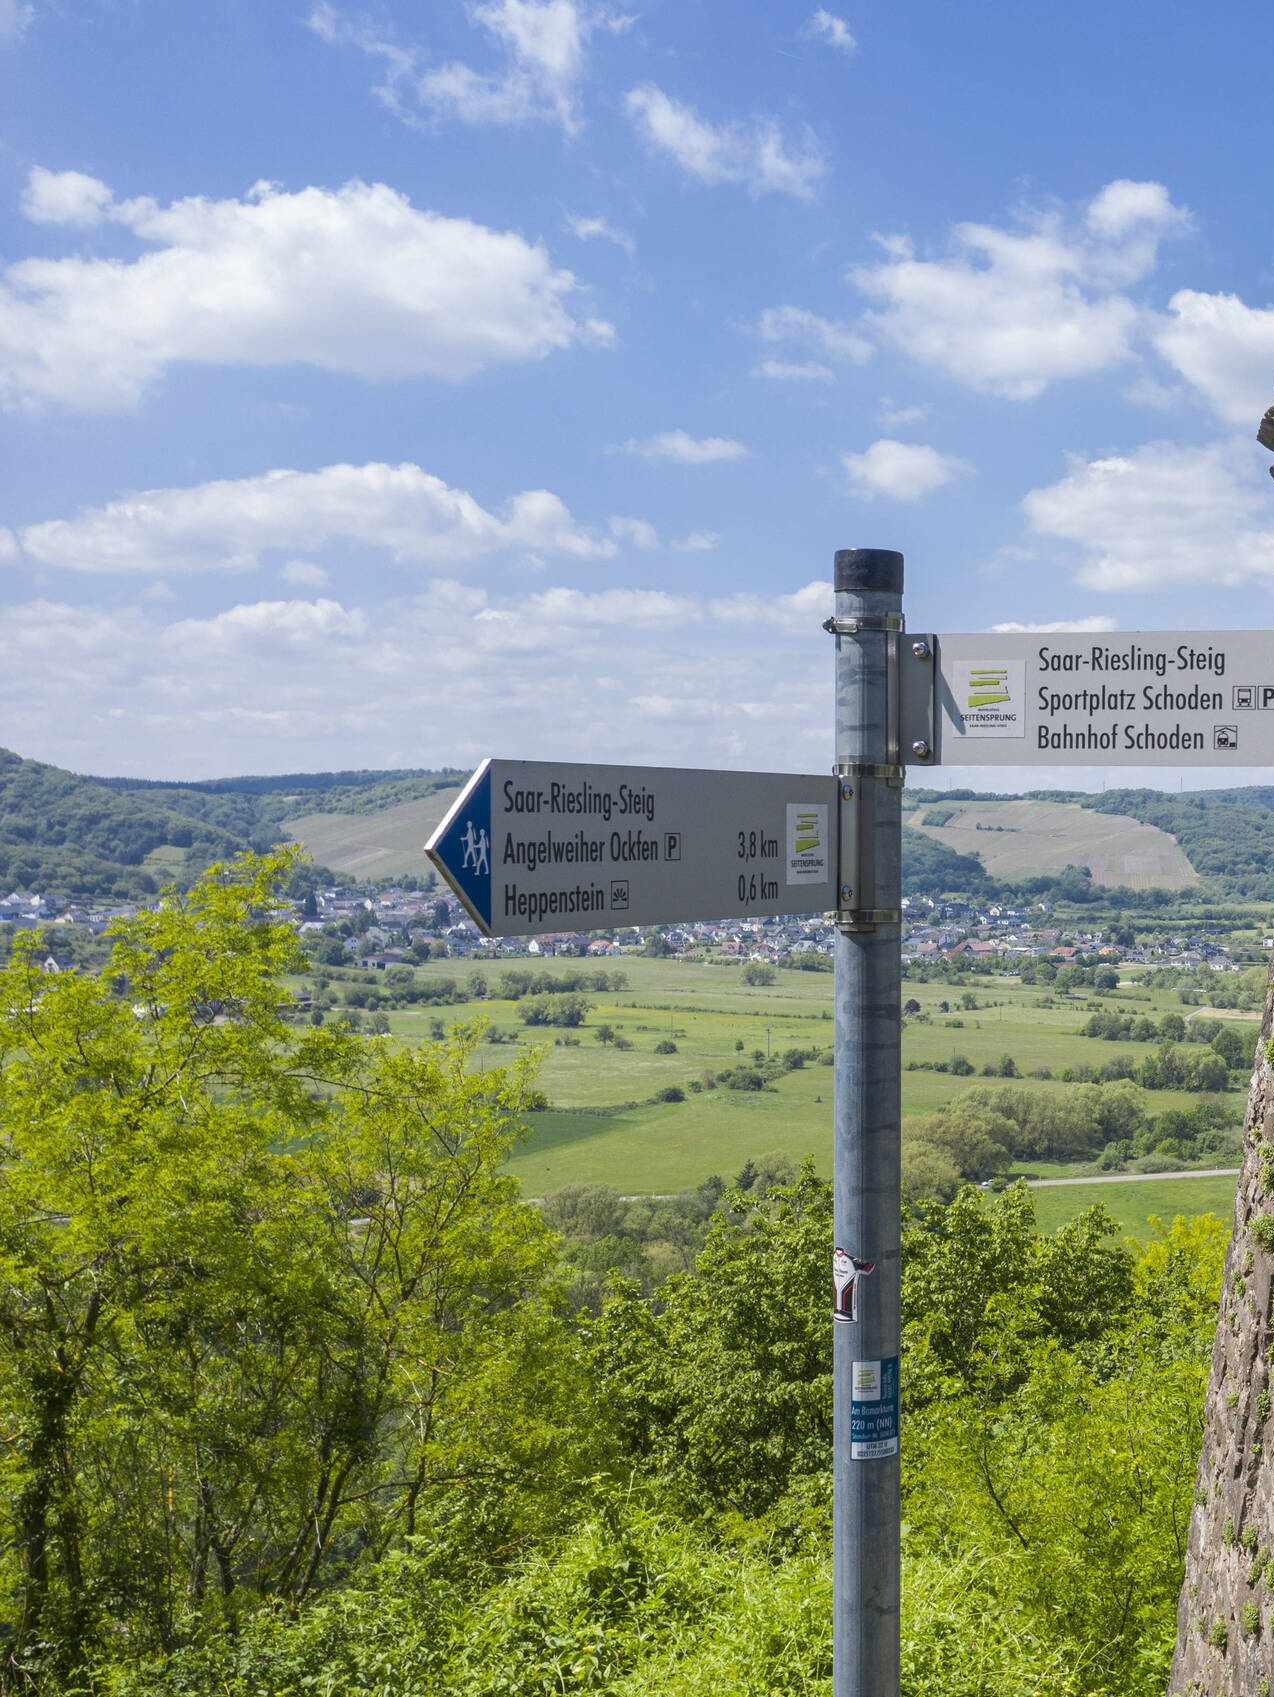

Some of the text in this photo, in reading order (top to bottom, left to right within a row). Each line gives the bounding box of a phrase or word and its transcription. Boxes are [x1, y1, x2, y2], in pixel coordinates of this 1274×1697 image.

[1038, 645, 1225, 677] Saar-Riesling-Steig
[1038, 684, 1136, 717] Sportplatz
[1142, 684, 1223, 711] Schoden
[959, 713, 1017, 722] SEITENSPRUNG
[1037, 723, 1119, 750] Bahnhof
[1124, 723, 1204, 750] Schoden
[503, 780, 655, 822] Saar-Riesling-Steig
[503, 830, 606, 872] Angelweiher
[609, 830, 659, 862] Ockfen
[737, 831, 757, 863] 3,8
[760, 830, 779, 858] km
[504, 872, 779, 924] Heppenstein 0,6 km
[852, 1416, 892, 1431] 220 m (NN)
